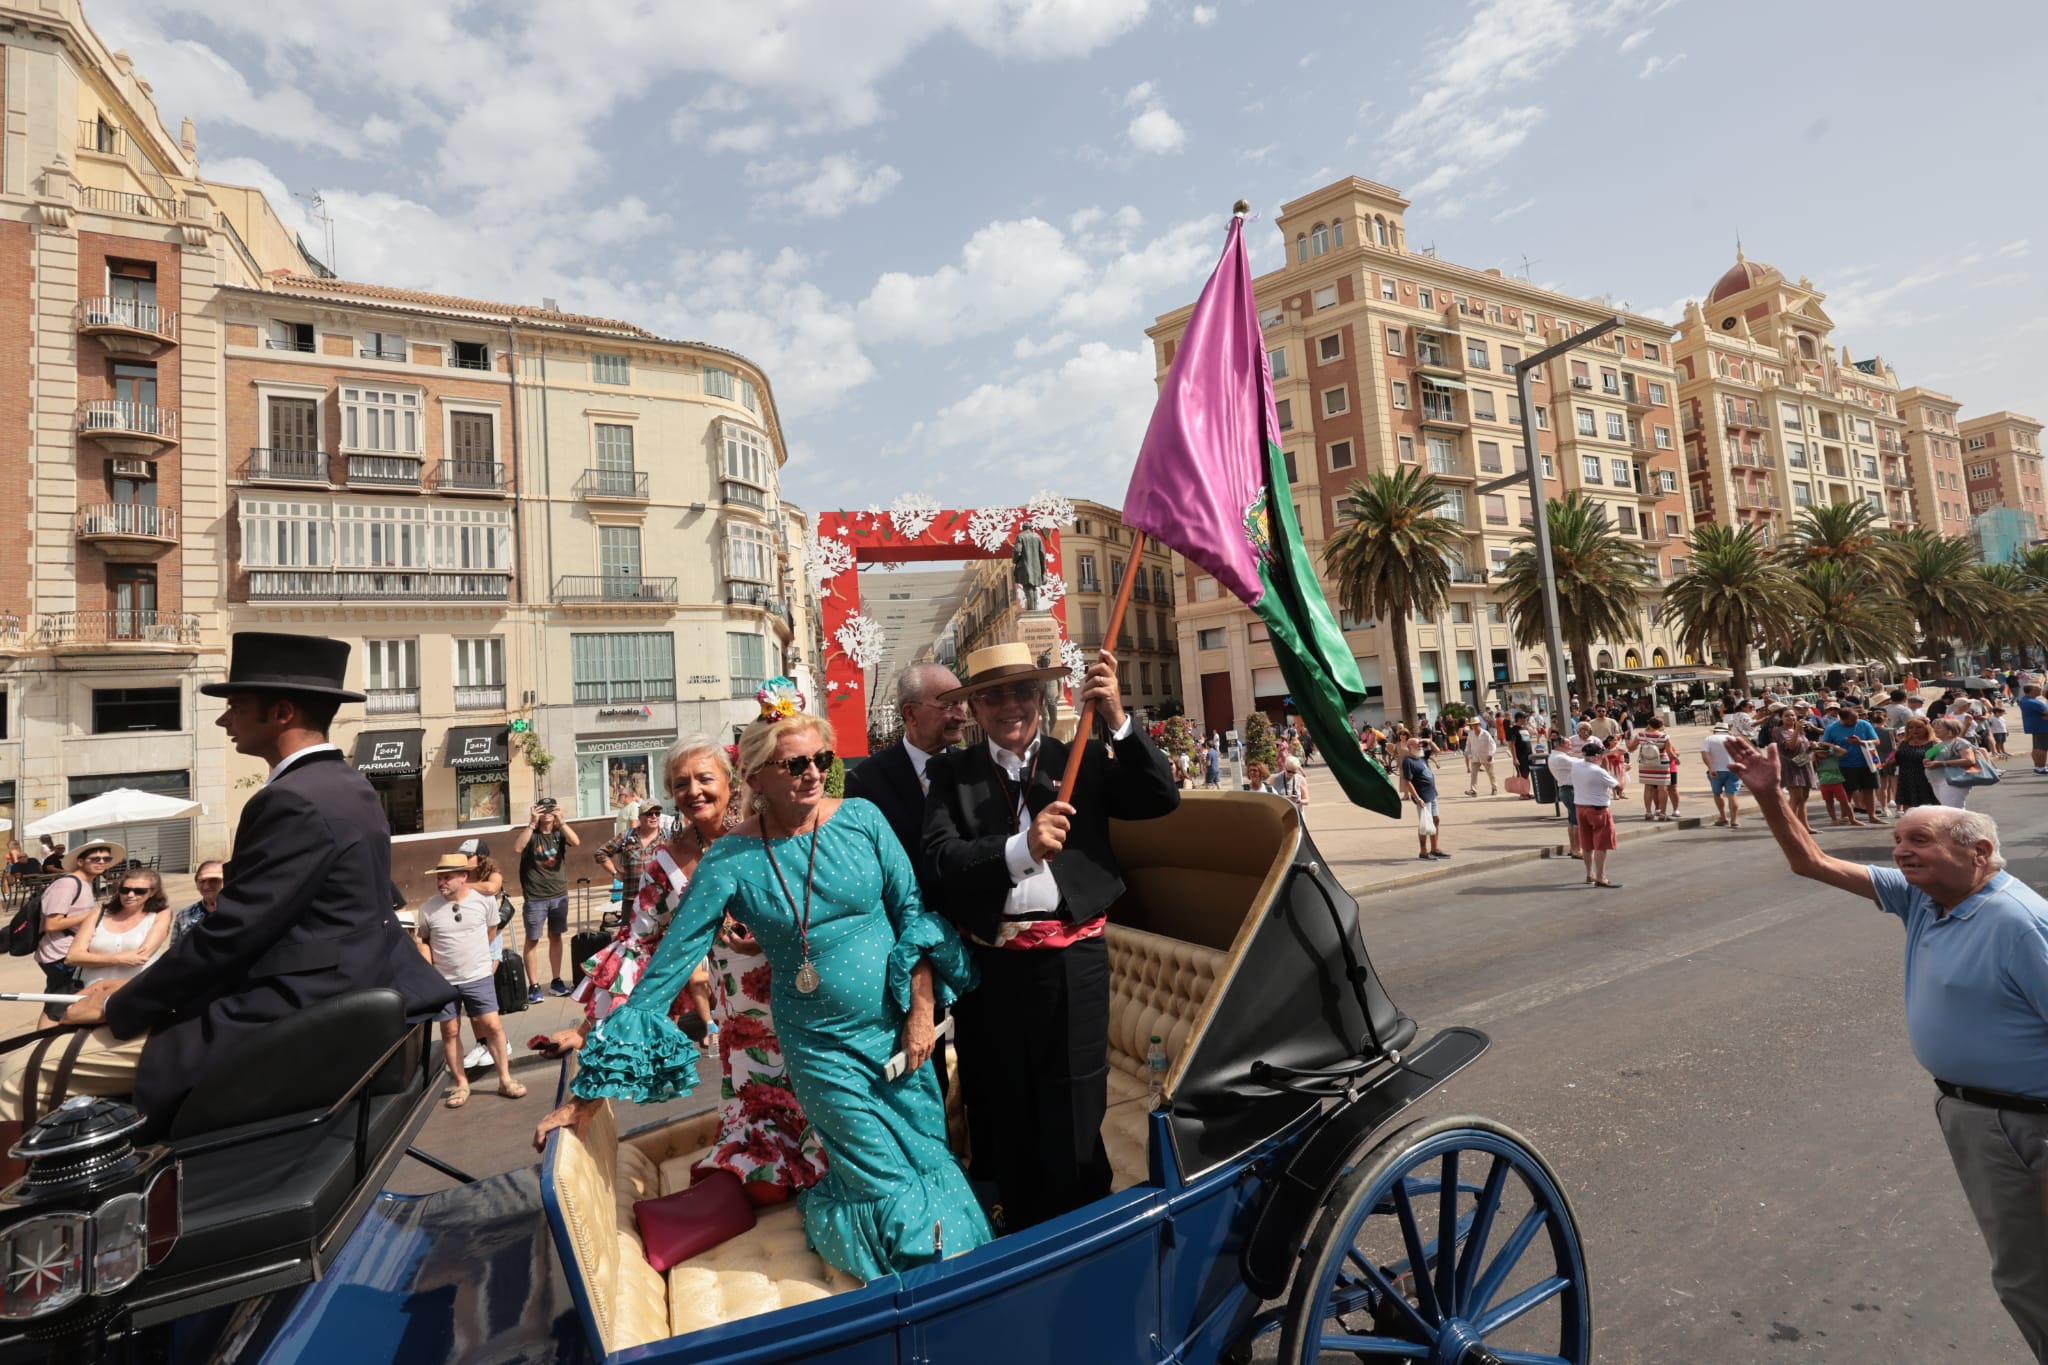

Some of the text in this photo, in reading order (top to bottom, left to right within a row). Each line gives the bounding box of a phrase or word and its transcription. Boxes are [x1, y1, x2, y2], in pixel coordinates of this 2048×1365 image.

[600, 708, 640, 717] helvetia
[469, 742, 487, 750] 24H
[588, 739, 665, 752] women'secret
[379, 747, 398, 755] 24H
[451, 755, 500, 765] FARMACIA
[358, 760, 411, 771] FARMACIA
[458, 772, 509, 784] 24HORAS
